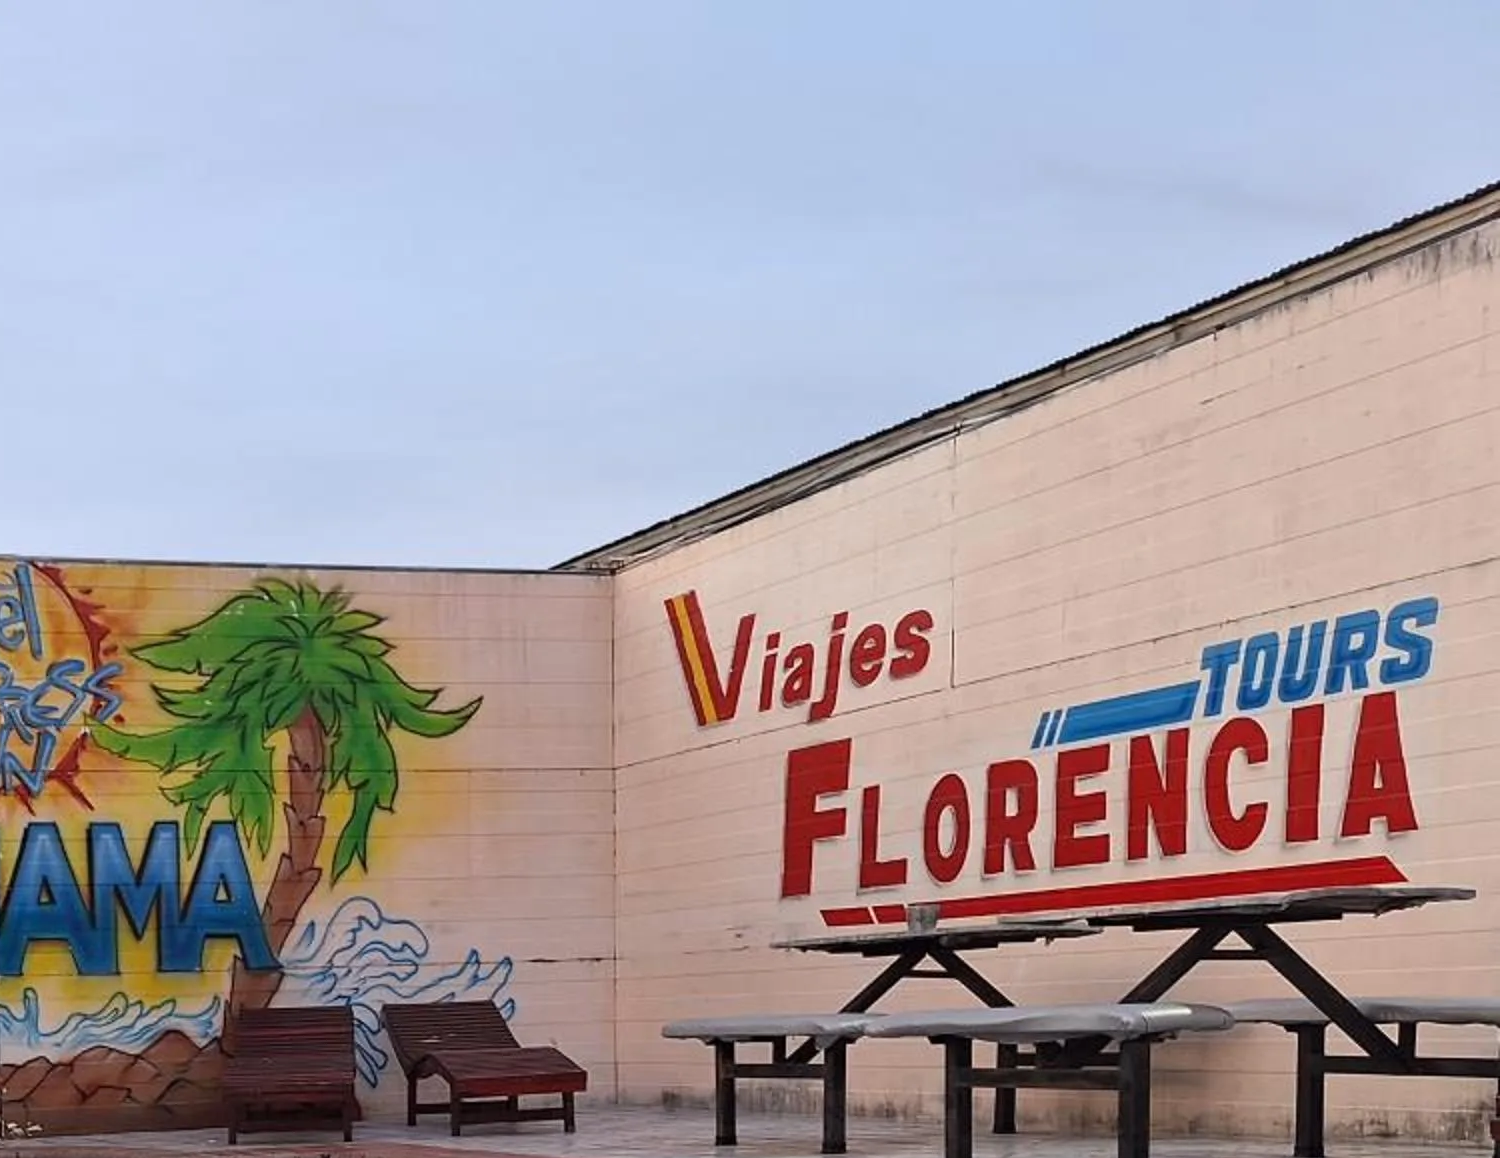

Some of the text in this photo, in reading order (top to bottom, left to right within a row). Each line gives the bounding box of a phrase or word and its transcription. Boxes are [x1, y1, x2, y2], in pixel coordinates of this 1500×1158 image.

[665, 591, 933, 723] Viajes
[1201, 597, 1439, 717] TOURS
[781, 691, 1418, 898] FLORENCIA
